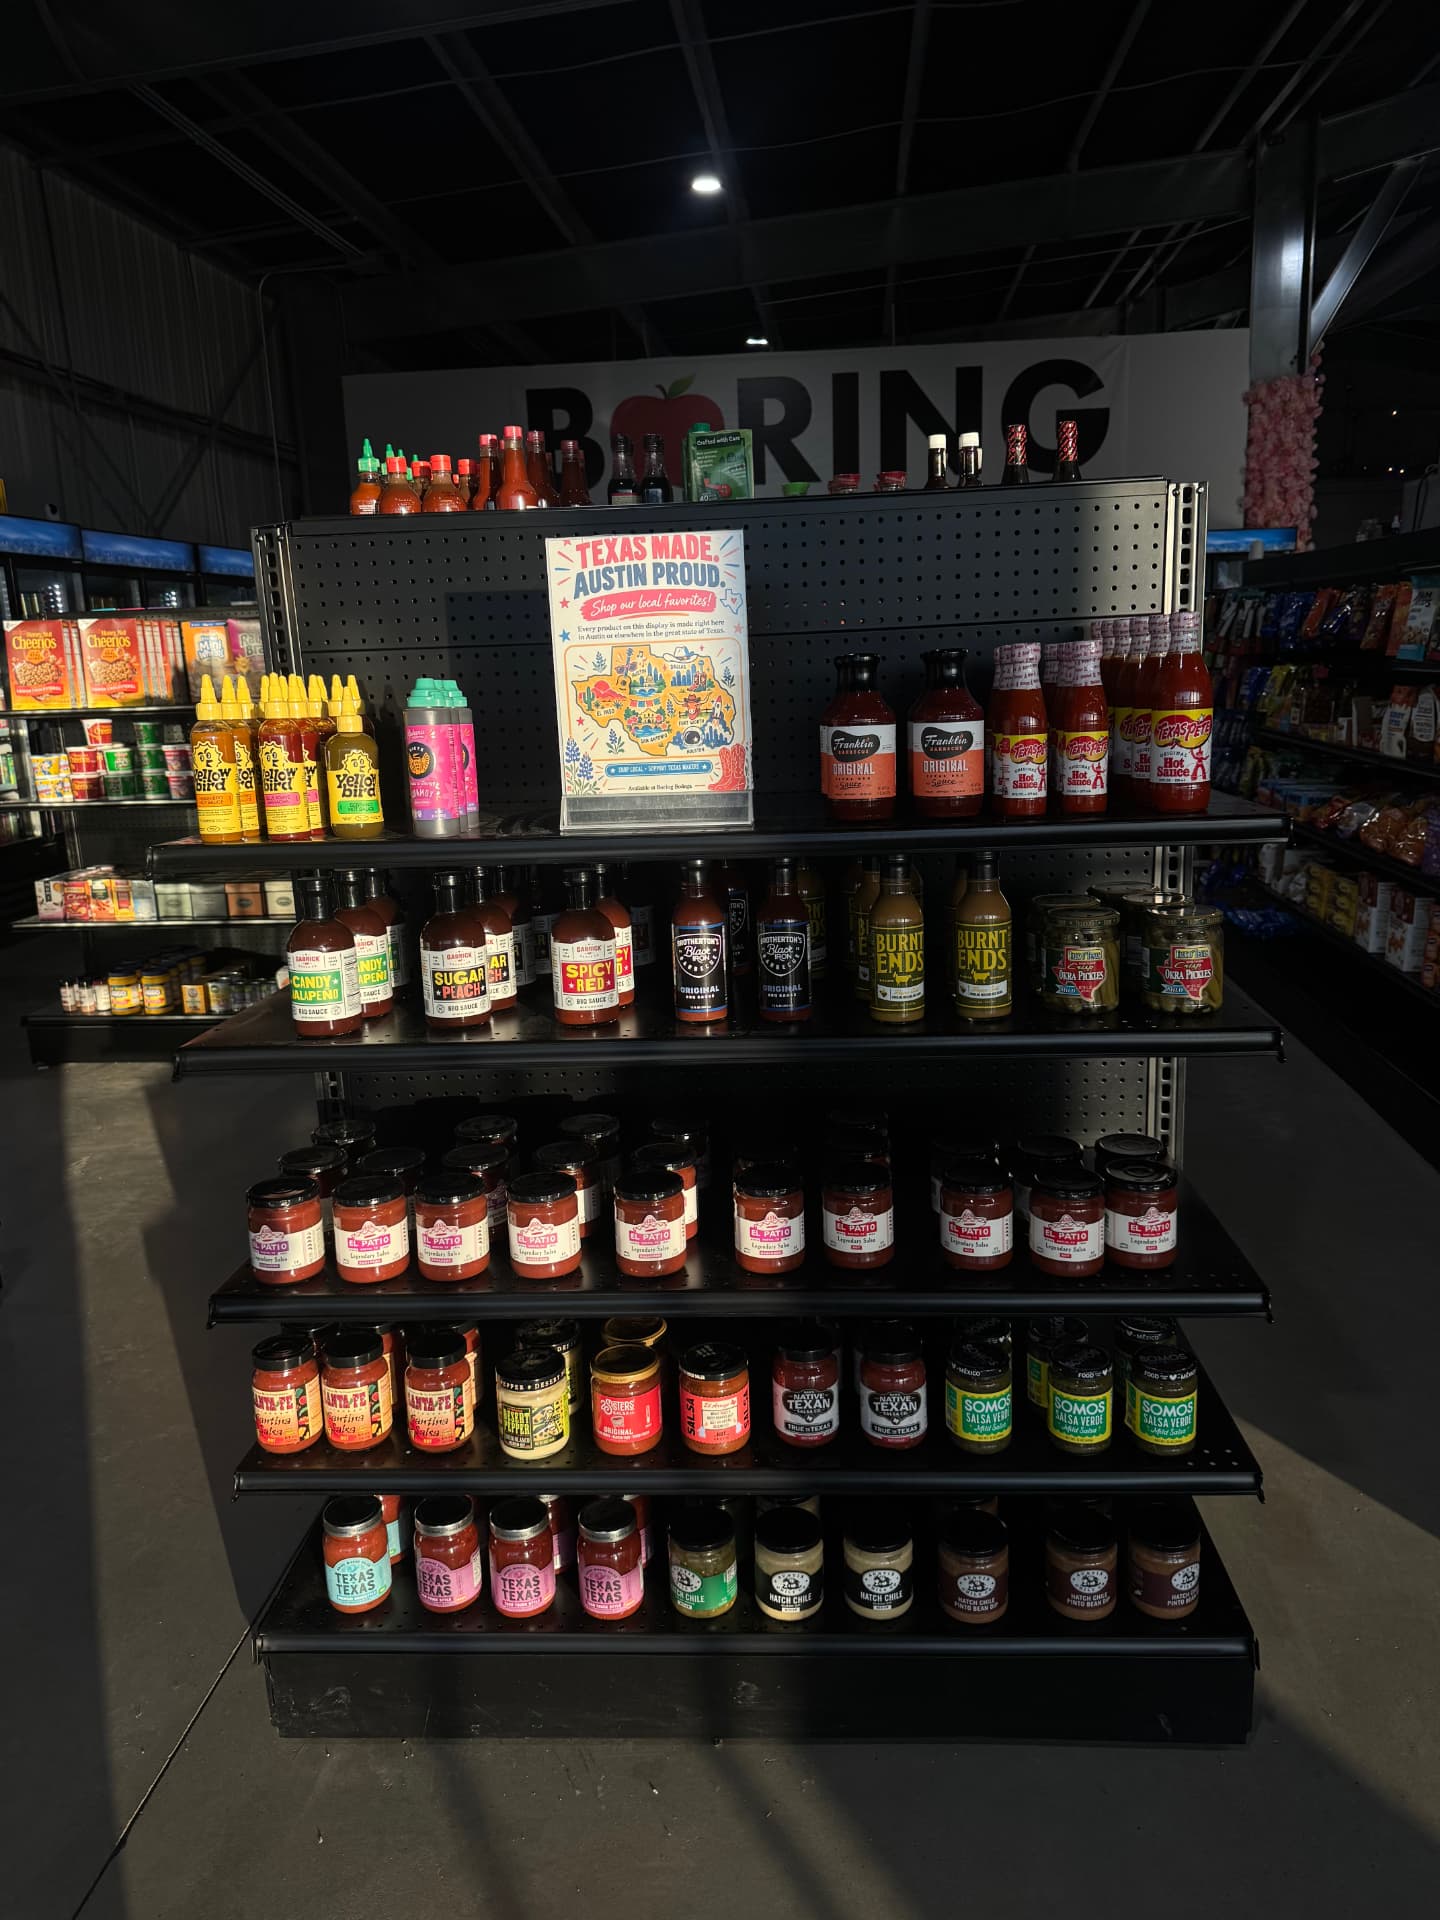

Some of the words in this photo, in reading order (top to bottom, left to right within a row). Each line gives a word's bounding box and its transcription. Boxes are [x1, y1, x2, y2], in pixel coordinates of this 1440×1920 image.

[576, 536, 647, 569] TEXAS
[651, 534, 719, 562] MADE.
[574, 563, 647, 600] AUSTIN
[652, 562, 726, 588] PROUD.
[590, 600, 617, 616] Shop
[620, 600, 634, 610] our
[638, 594, 662, 609] local
[663, 593, 712, 609] favorites!
[577, 625, 597, 634] Every
[597, 624, 622, 633] product
[632, 622, 644, 630] this
[645, 622, 669, 631] display
[676, 620, 694, 628] made
[694, 620, 710, 628] right
[87, 634, 131, 648] Cheerios
[614, 631, 645, 639] elsewhere
[664, 630, 681, 638] great
[12, 635, 57, 650] Cheerios
[1157, 720, 1186, 739] TEXAS
[833, 737, 875, 750] Franklin
[924, 734, 968, 748] Franklin
[1070, 741, 1092, 754] TEXAS
[1014, 744, 1039, 757] TEXAS
[832, 762, 876, 775] ORIGINAL
[923, 759, 968, 772] ORIGINAL
[1163, 757, 1184, 768] Hot
[1018, 773, 1034, 782] Hot
[1072, 770, 1088, 779] Hot
[1156, 766, 1190, 777] Sauce
[1012, 780, 1038, 789] Sauce
[1067, 777, 1092, 786] Sauce
[342, 784, 376, 798] bird
[876, 931, 924, 953] BURNT
[958, 929, 1007, 950] BURNT
[684, 945, 711, 958] Black
[766, 943, 793, 956] Black
[876, 950, 924, 974] ENDS
[958, 948, 1007, 970] ENDS
[566, 960, 612, 979] SPICY
[1058, 970, 1077, 981] OKRA
[1165, 970, 1184, 981] OKRA
[292, 975, 332, 989] CANDY
[434, 967, 485, 986] SUGAR
[442, 982, 481, 1000] PEACH
[576, 977, 605, 993] RED
[680, 984, 720, 995] ORIGINAL
[762, 984, 803, 994] ORIGINAL
[588, 996, 607, 1004] SAUCE
[460, 1003, 478, 1011] SAUCE
[763, 1229, 790, 1238] PATIO
[836, 1223, 846, 1231] EL
[848, 1223, 876, 1232] PATIO
[950, 1224, 959, 1233] EL
[961, 1226, 989, 1236] PATIO
[1129, 1224, 1140, 1232] EL
[1142, 1223, 1170, 1232] PATIO
[361, 1236, 390, 1247] PATIO
[518, 1236, 528, 1244] EL
[529, 1236, 556, 1245] PATIO
[630, 1232, 641, 1240] EL
[642, 1232, 670, 1241] PATIO
[1044, 1230, 1055, 1238] EL
[1058, 1231, 1087, 1241] PATIO
[793, 1393, 825, 1401] NATIVE
[879, 1395, 912, 1403] NATIVE
[964, 1393, 1011, 1413] SOMOS
[787, 1398, 831, 1410] TEXAN
[873, 1401, 918, 1412] TEXAN
[1054, 1395, 1106, 1416] SOMOS
[1142, 1400, 1193, 1418] SOMOS
[687, 1398, 695, 1436] SALSA
[966, 1411, 991, 1424] SALSA
[1055, 1409, 1078, 1425] SALSA
[1079, 1414, 1103, 1427] VERDE
[1143, 1413, 1169, 1428] SALSA
[1170, 1414, 1192, 1428] VERDE
[787, 1423, 805, 1431] TRUE
[810, 1422, 831, 1432] TEXAS
[874, 1425, 891, 1434] TRUE
[897, 1424, 918, 1435] TEXAS
[334, 1568, 375, 1585] TEXAS
[500, 1575, 541, 1590] TEXAS
[336, 1580, 376, 1596] TEXAS
[584, 1576, 622, 1593] TEXAS
[502, 1586, 541, 1602] TEXAS
[584, 1588, 622, 1604] TEXAS
[685, 1594, 705, 1603] CHILE
[769, 1592, 792, 1604] HATCH
[792, 1592, 813, 1604] CHILE
[860, 1591, 883, 1602] HATCH
[884, 1590, 903, 1602] CHILE
[954, 1601, 972, 1611] PINTO
[972, 1604, 990, 1612] BEAN
[957, 1596, 977, 1606] HATCH
[979, 1597, 996, 1605] CHILE
